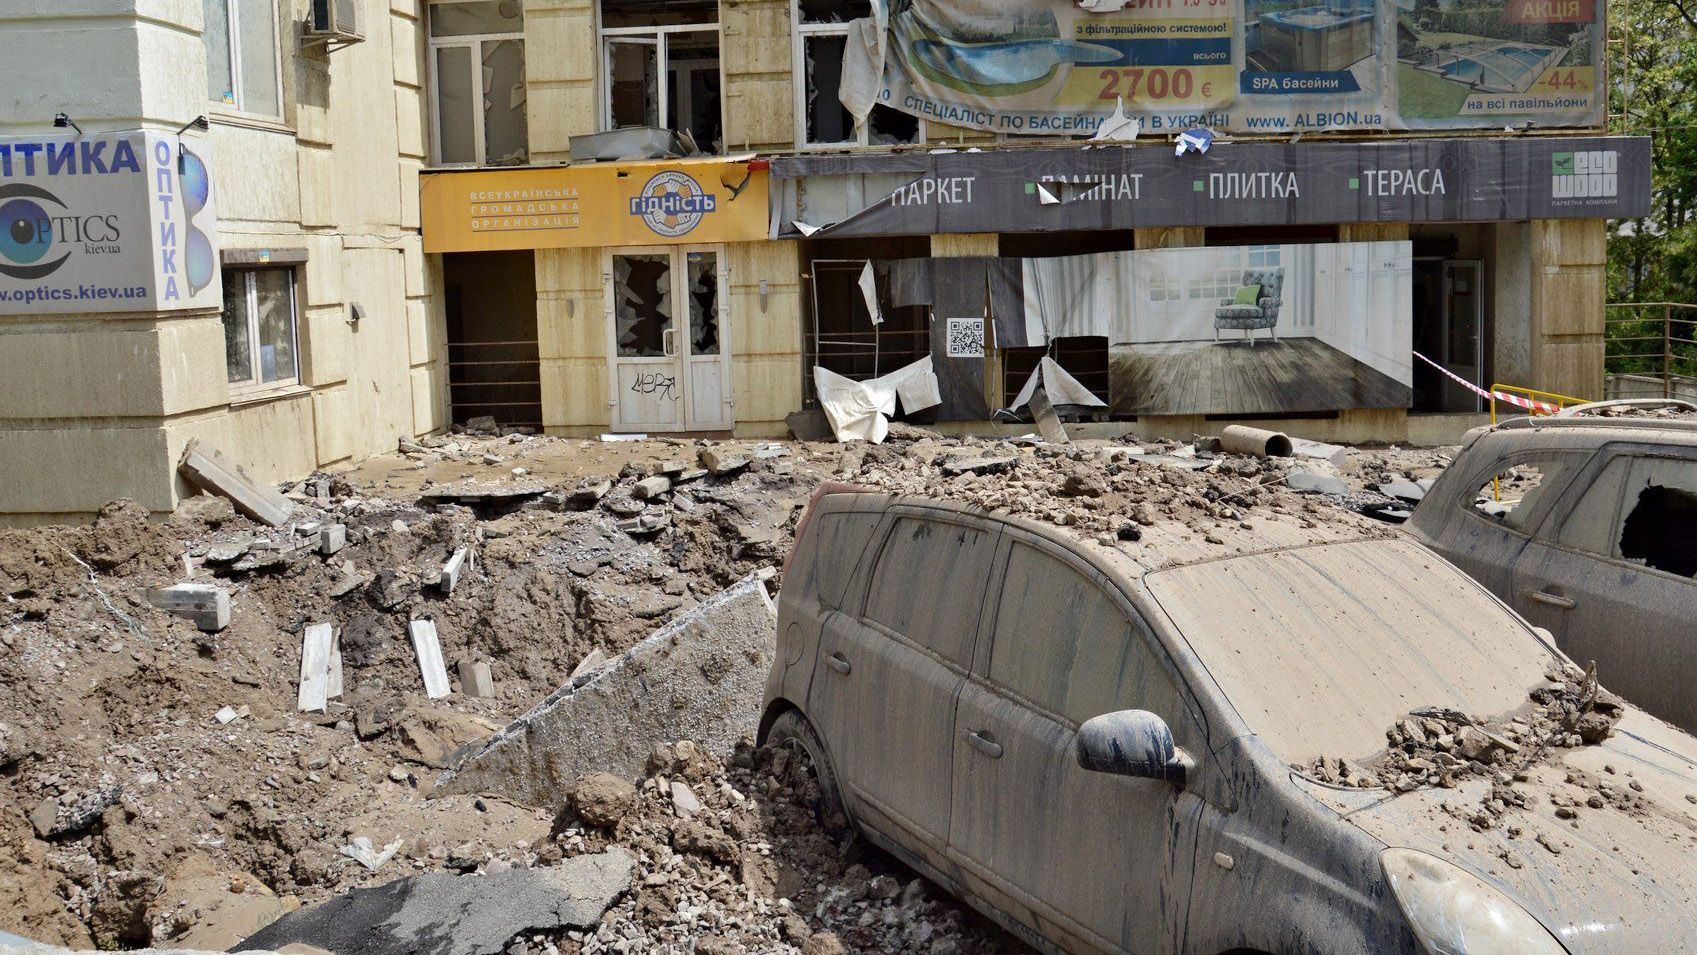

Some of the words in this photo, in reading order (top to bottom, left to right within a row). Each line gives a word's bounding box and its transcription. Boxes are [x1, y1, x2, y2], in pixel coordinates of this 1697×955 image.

[1522, 1, 1580, 20] АКЦІЯ
[1086, 23, 1166, 36] фільтраційною
[1169, 22, 1228, 33] системою!
[1193, 51, 1227, 60] всього
[1099, 68, 1194, 100] 2700
[1253, 77, 1278, 89] SPA
[1282, 77, 1339, 89] басейни
[1467, 100, 1483, 109] на
[1487, 98, 1505, 109] всі
[1509, 97, 1588, 109] павільйони
[903, 95, 996, 127] СПЕЦІАЛІСТ
[1000, 115, 1024, 129] ПО
[1151, 115, 1163, 128] В
[1168, 112, 1230, 128] УКРАЇНІ
[1246, 116, 1290, 128] www.
[1294, 111, 1382, 127] ALBION.ua
[1209, 172, 1300, 199] ПЛИТКА
[1364, 168, 1446, 196] ТЕРАСА
[471, 202, 579, 214] ГРОМАДСЬКА
[154, 140, 181, 301] ОПТИКА
[471, 216, 580, 229] ОРГАНІЗАЦІЯ
